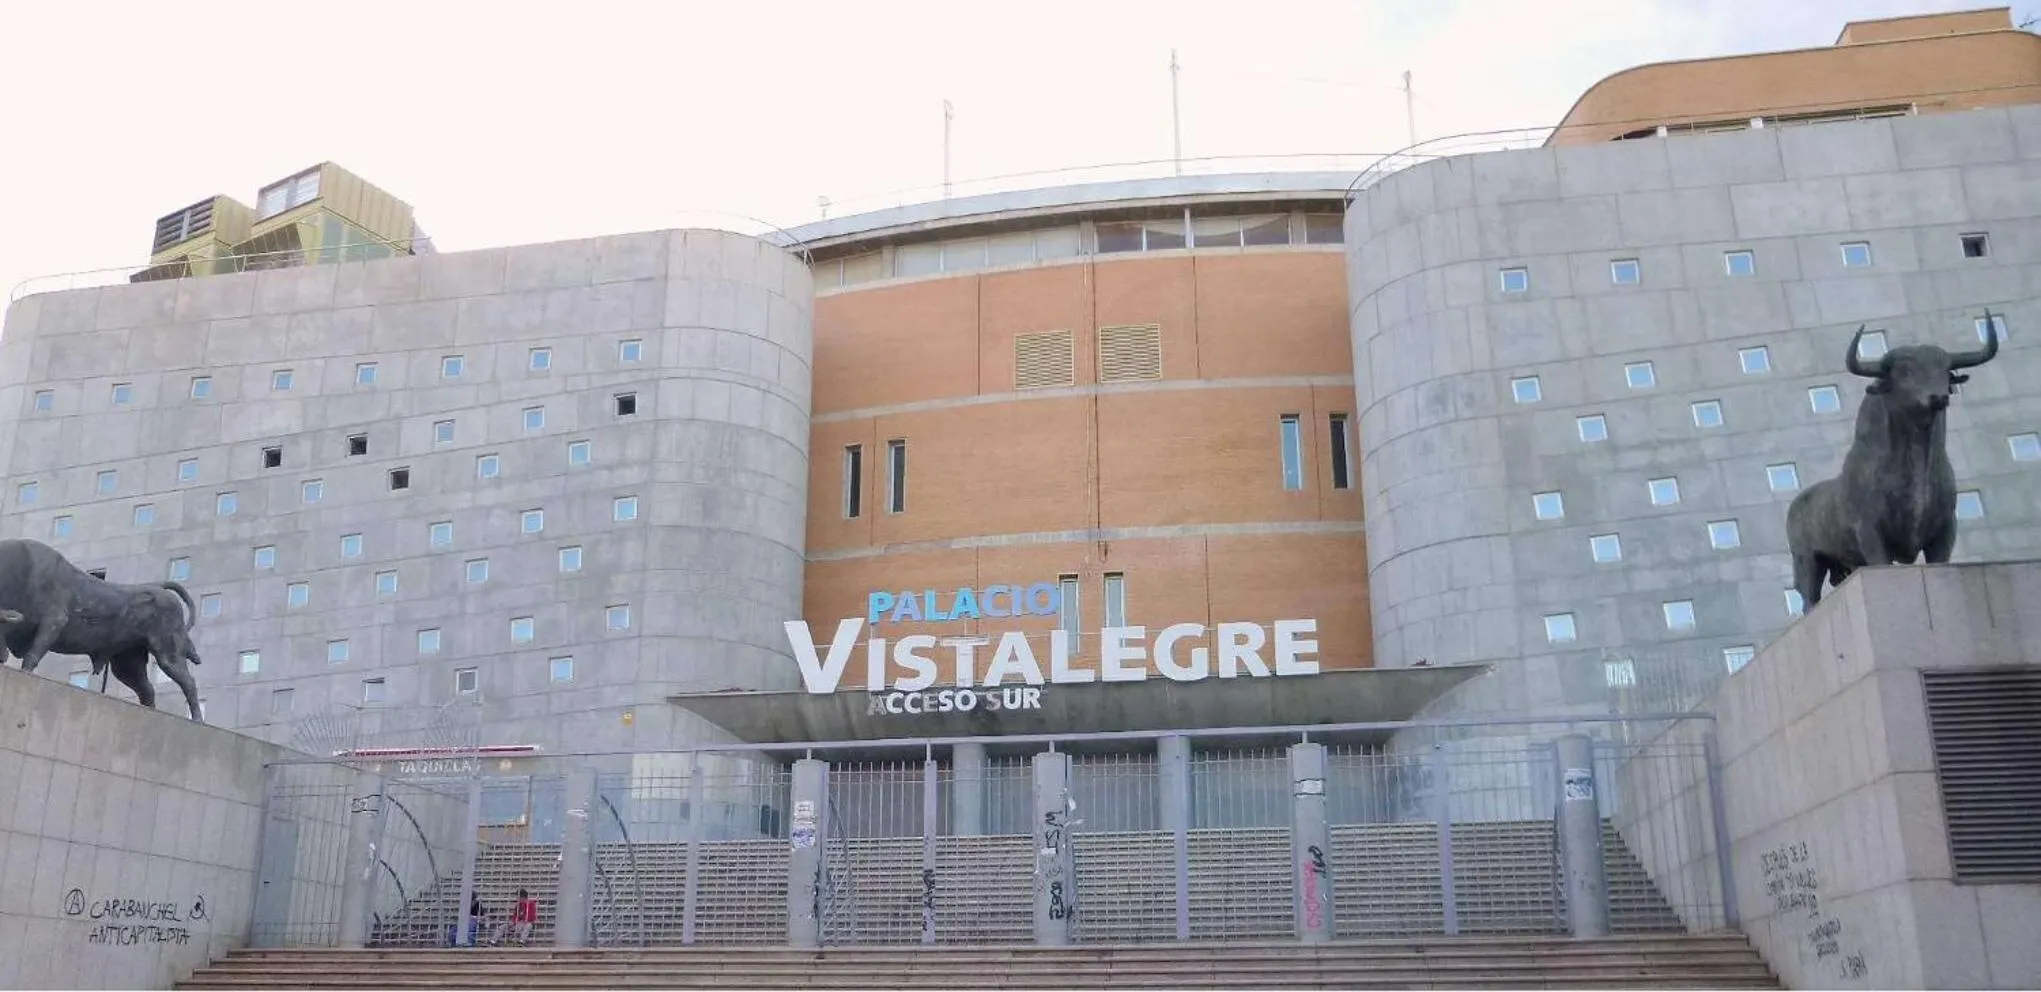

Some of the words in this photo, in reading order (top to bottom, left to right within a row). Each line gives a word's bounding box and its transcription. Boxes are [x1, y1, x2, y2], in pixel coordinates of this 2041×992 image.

[868, 581, 1060, 625] PALACIO
[783, 617, 1320, 694] VISTALEGRE
[867, 688, 978, 716] ACCESO
[986, 687, 1042, 713] SUR
